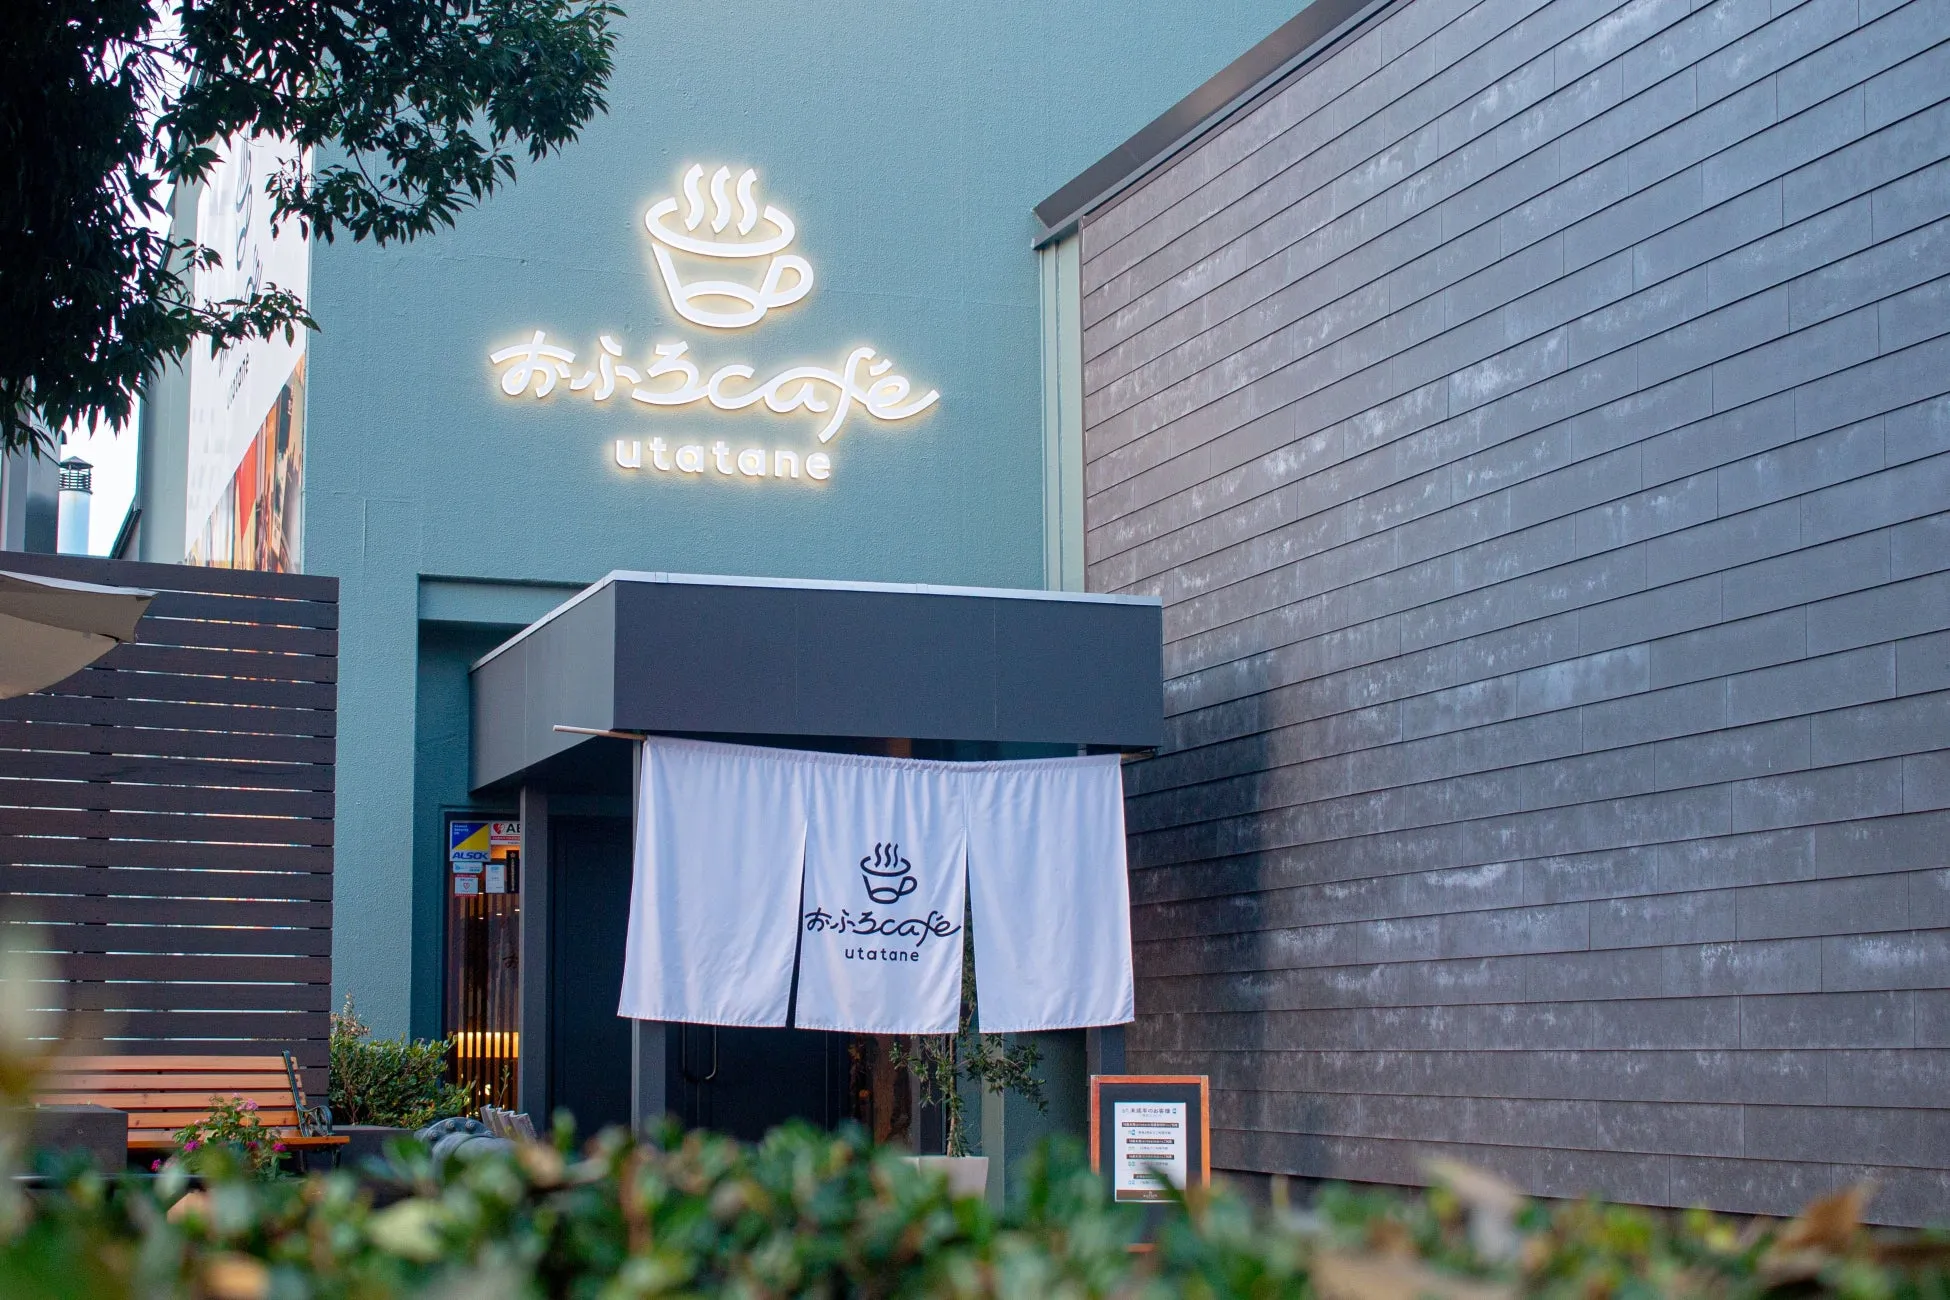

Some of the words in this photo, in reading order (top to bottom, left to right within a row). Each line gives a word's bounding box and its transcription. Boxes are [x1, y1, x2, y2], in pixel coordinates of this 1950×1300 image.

[615, 436, 831, 480] utatane
[452, 851, 488, 860] ALSOK
[845, 947, 919, 962] utatane
